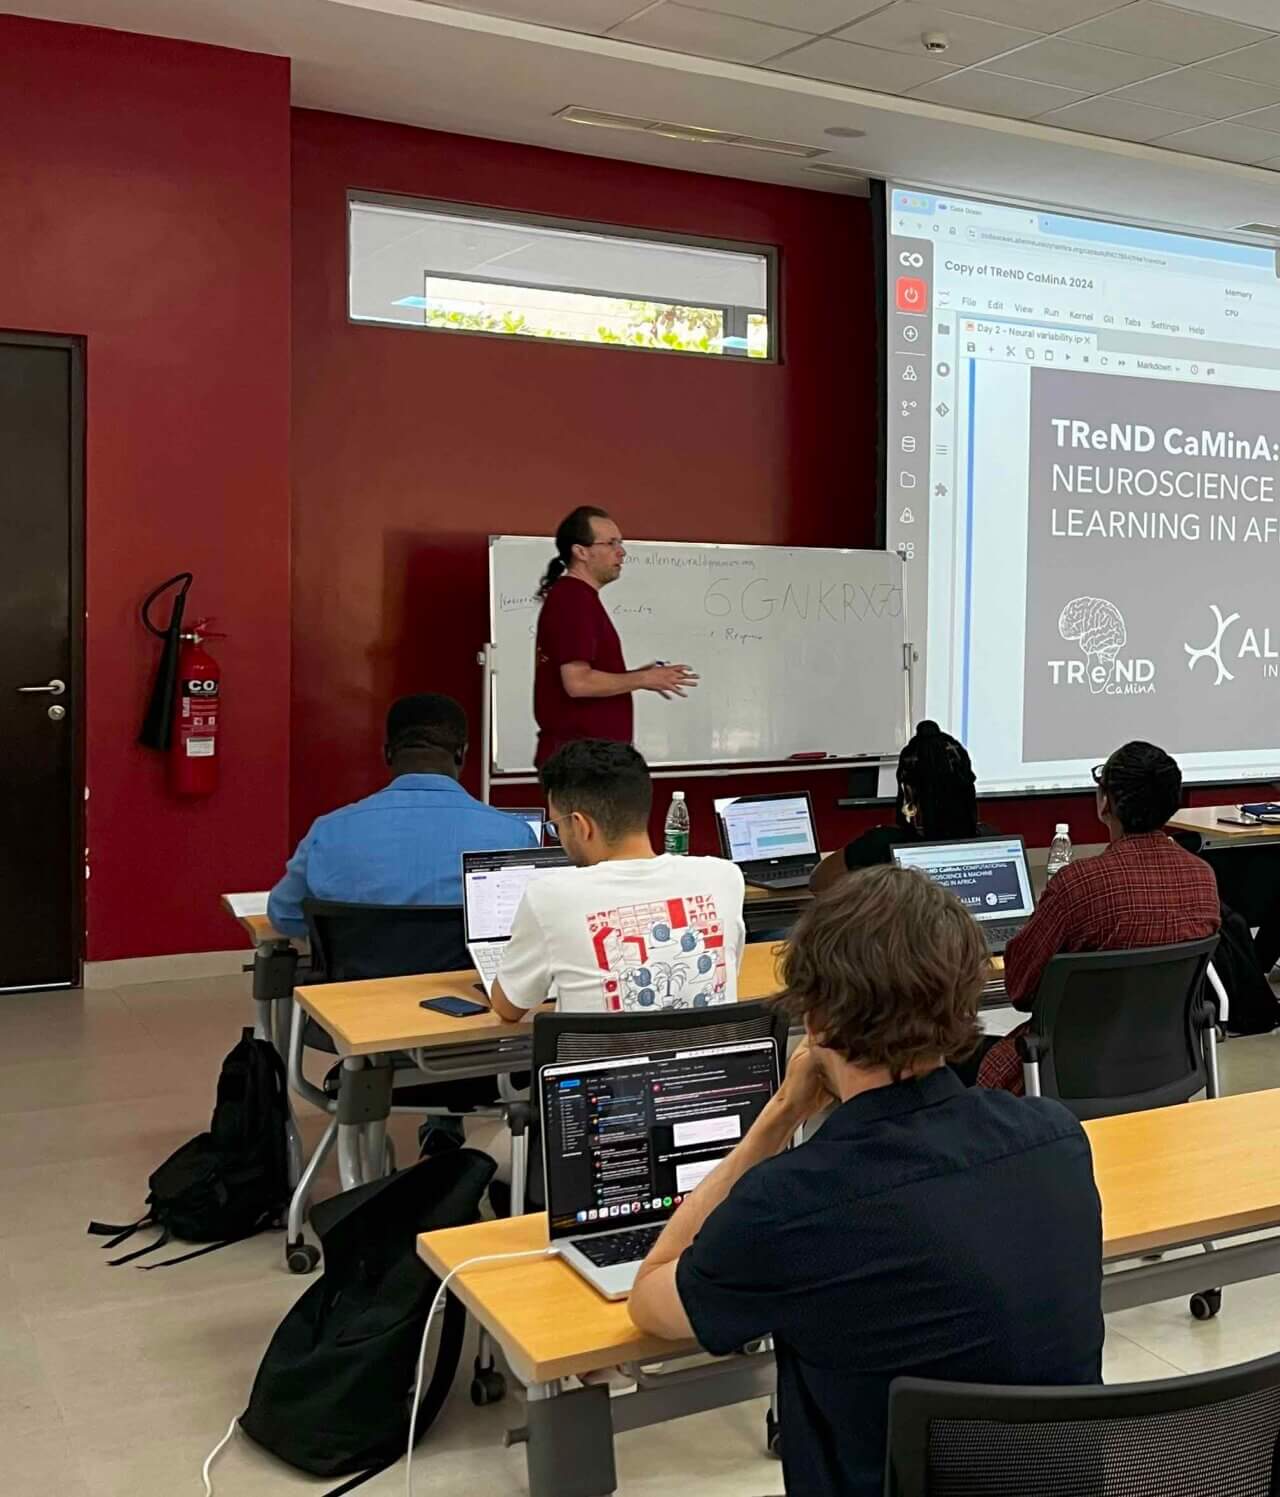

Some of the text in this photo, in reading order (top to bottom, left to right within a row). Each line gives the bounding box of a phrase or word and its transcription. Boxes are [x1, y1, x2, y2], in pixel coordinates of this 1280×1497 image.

[944, 260, 1094, 289] Copy of TReND CaMinA 2024
[962, 296, 977, 307] File
[987, 300, 1004, 311] Edit
[1014, 303, 1033, 315] View
[1044, 307, 1060, 318] Run
[1069, 310, 1093, 322] Kernel
[1124, 317, 1142, 328] Tabs
[1151, 320, 1180, 333] Settings
[977, 323, 993, 336] Day
[995, 326, 1001, 334] 2
[1009, 327, 1035, 338] Neural
[1136, 360, 1172, 373] Markdown
[1051, 419, 1156, 452] TReND
[1163, 427, 1280, 462] CaMinA:
[1052, 463, 1274, 503] NEUROSCIENCE
[1051, 508, 1201, 540] LEARNING
[1210, 514, 1236, 542] IN
[188, 680, 217, 691] CO
[1047, 659, 1155, 685] TReND
[1105, 682, 1157, 695] CaMinA
